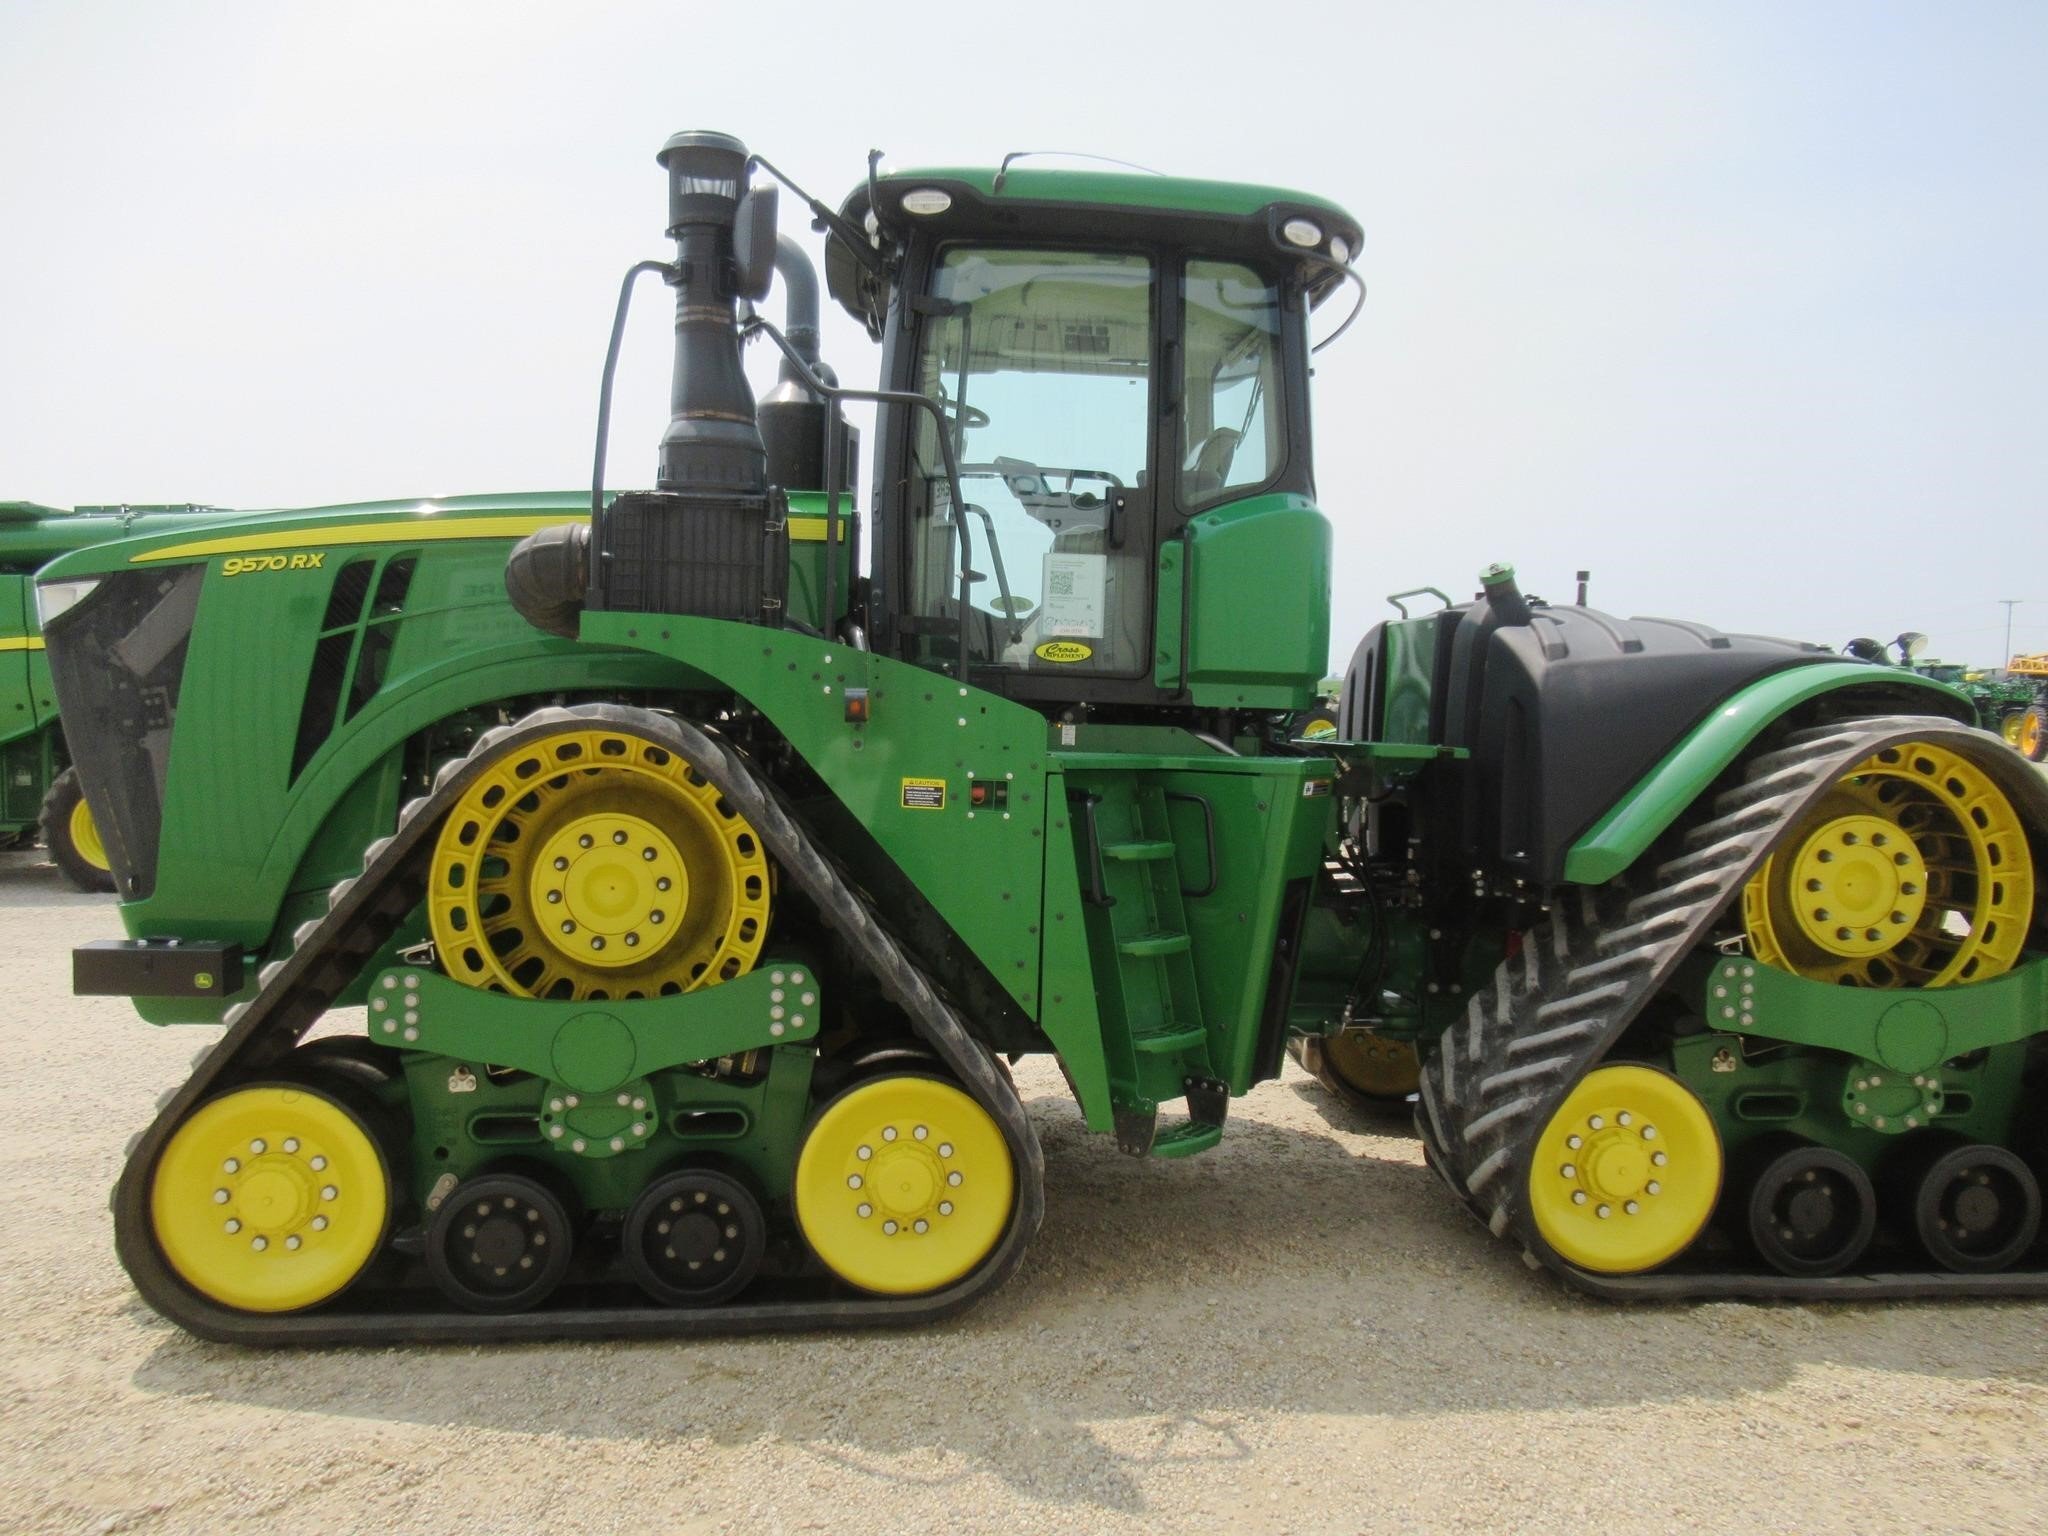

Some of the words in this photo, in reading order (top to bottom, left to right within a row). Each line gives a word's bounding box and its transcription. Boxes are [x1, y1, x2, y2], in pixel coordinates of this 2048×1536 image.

[222, 555, 287, 577] 9570
[290, 553, 326, 569] RX
[1045, 643, 1080, 654] Cross
